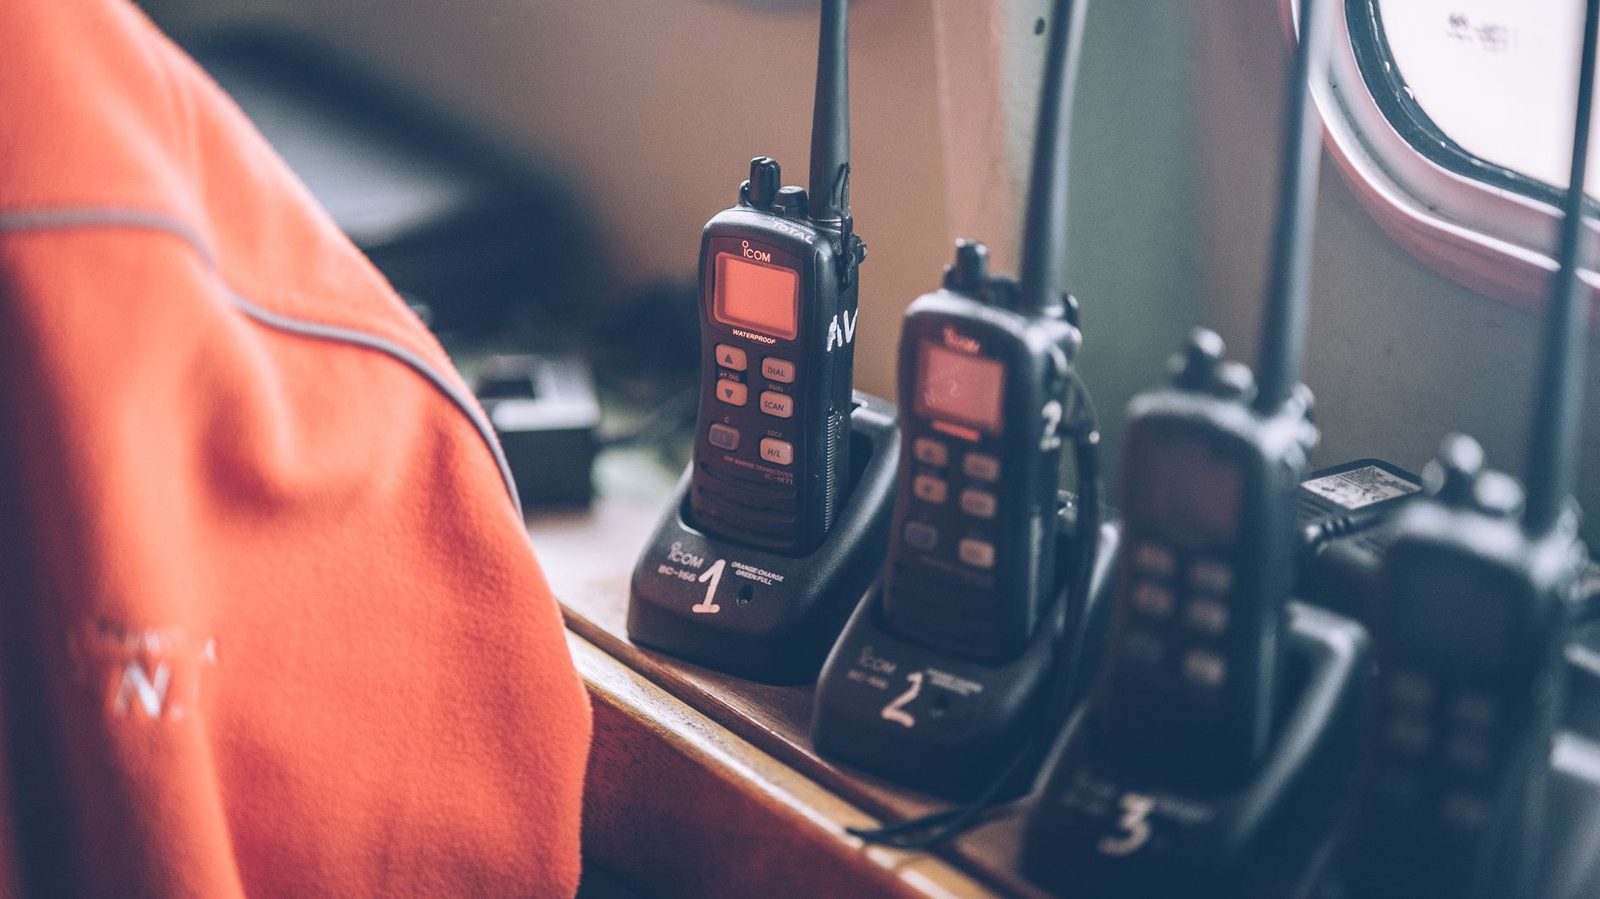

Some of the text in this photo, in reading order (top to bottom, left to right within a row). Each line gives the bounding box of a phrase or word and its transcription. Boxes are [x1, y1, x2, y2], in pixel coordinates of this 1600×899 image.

[732, 329, 776, 344] WATERPROOF
[767, 367, 786, 377] DIAL
[763, 400, 785, 412] SCAN
[1039, 401, 1063, 450] 2
[692, 559, 726, 614] 1
[880, 671, 924, 728] 2
[1099, 792, 1156, 856] 3
